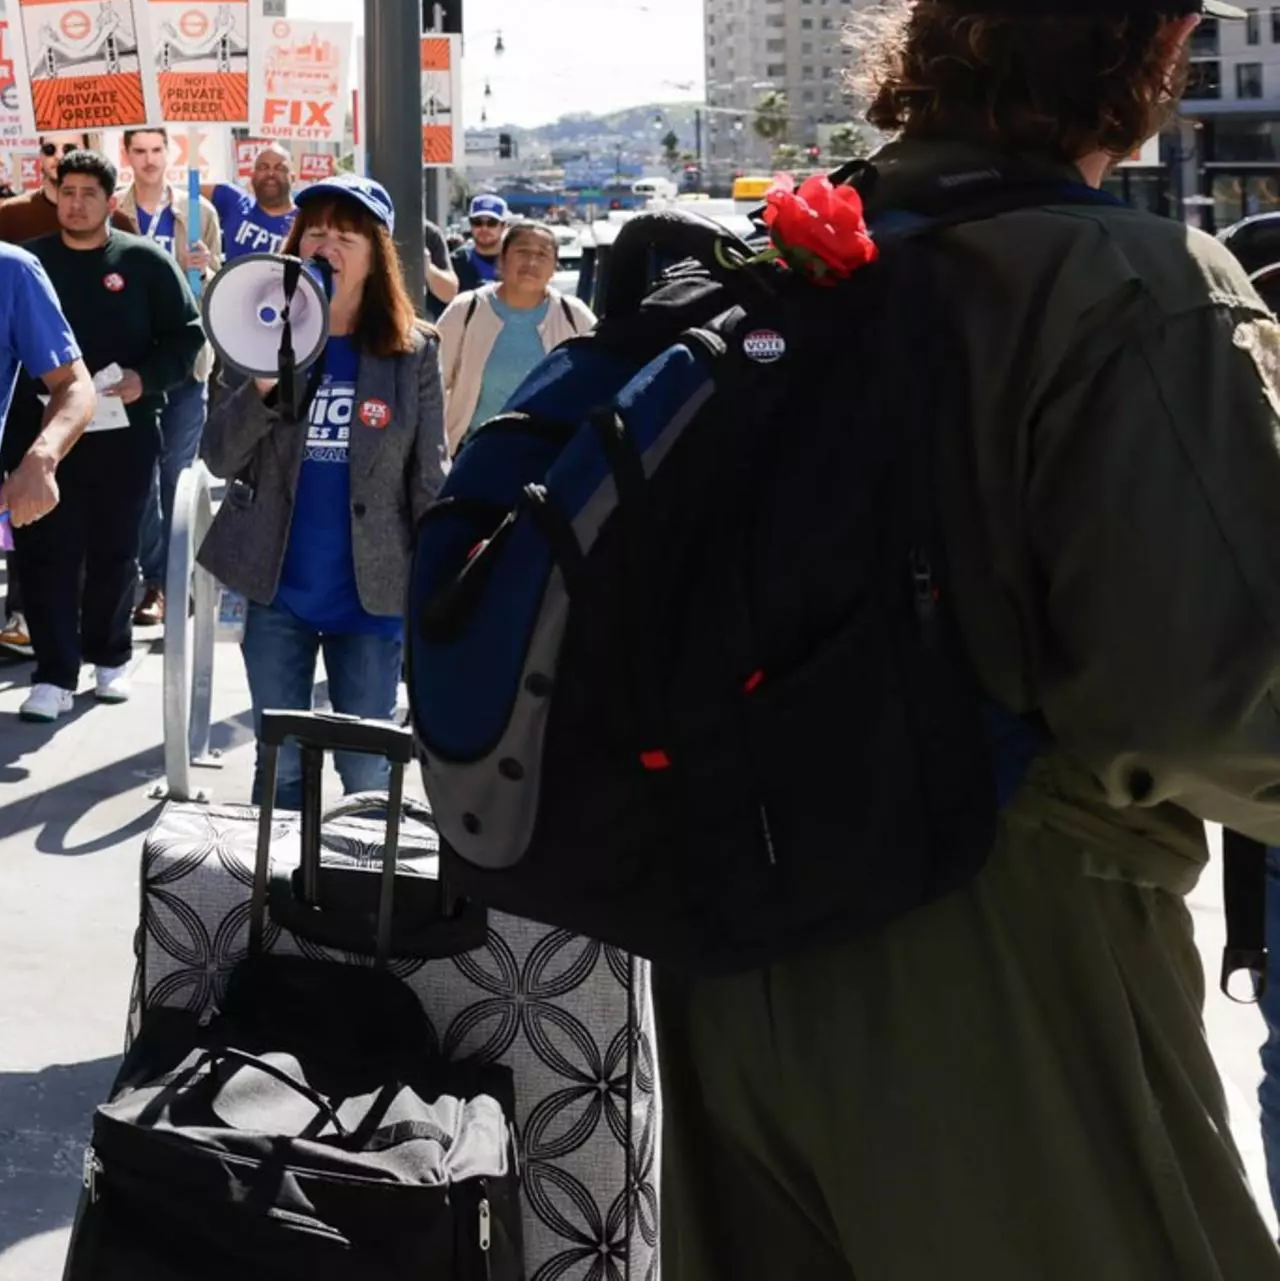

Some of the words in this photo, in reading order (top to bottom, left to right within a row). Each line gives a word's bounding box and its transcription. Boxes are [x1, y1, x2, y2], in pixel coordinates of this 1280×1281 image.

[73, 80, 97, 90] NOT
[184, 78, 207, 86] NOT
[56, 91, 119, 106] PRIVATE
[167, 88, 225, 100] PRIVATE
[263, 99, 334, 126] FIX
[260, 126, 292, 137] OUR
[296, 125, 333, 138] CITY
[235, 220, 283, 255] IFPT
[744, 339, 780, 351] VOTE
